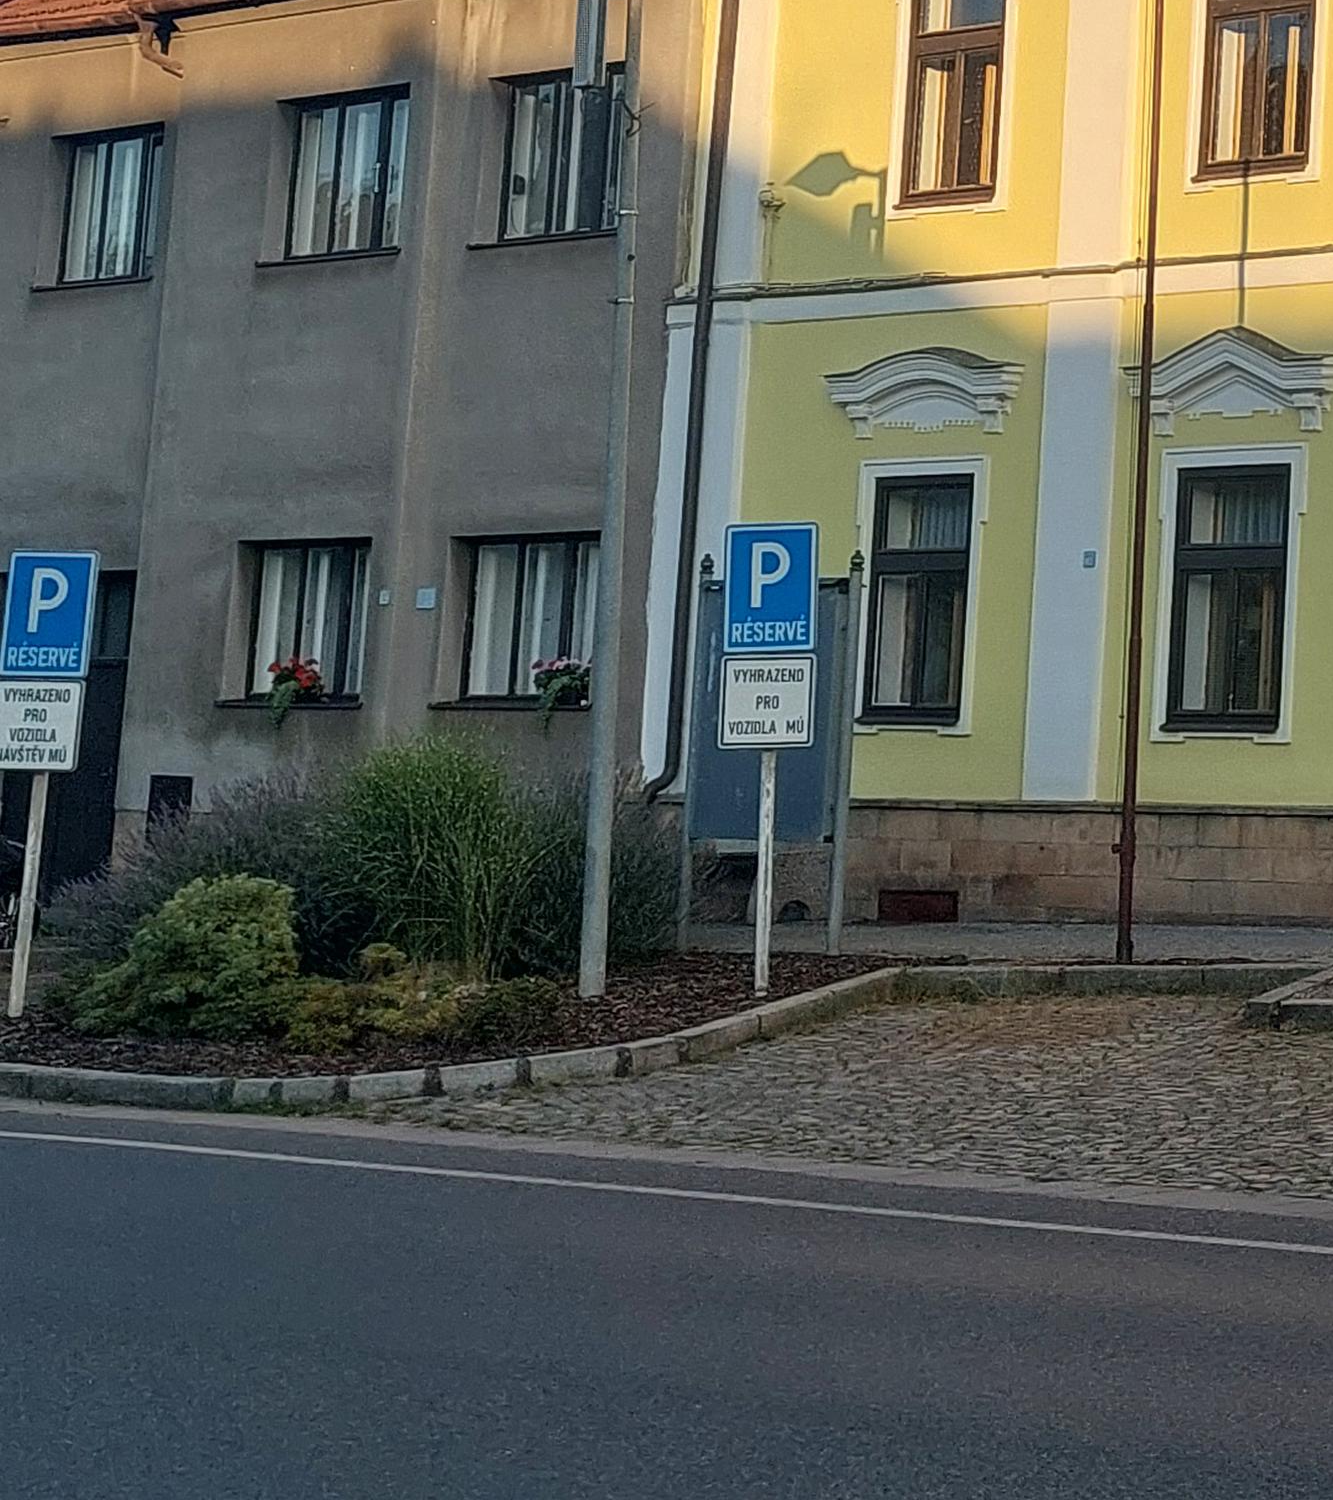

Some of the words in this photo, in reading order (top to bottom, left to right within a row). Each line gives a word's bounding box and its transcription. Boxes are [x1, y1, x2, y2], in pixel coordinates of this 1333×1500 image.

[750, 541, 791, 609] P
[27, 567, 69, 633] P
[731, 613, 807, 643] RÉSERVÉ
[6, 641, 80, 668] RÉSERVÉ
[733, 668, 805, 683] VYHRAZENO
[4, 688, 71, 703] VYHRAZENO
[755, 695, 780, 710] PRO
[23, 708, 48, 722] PRO
[728, 720, 777, 735] VOZIDLA
[785, 715, 804, 734] MÚ
[9, 728, 57, 742] VOZIDLA
[48, 744, 67, 763] MÚ
